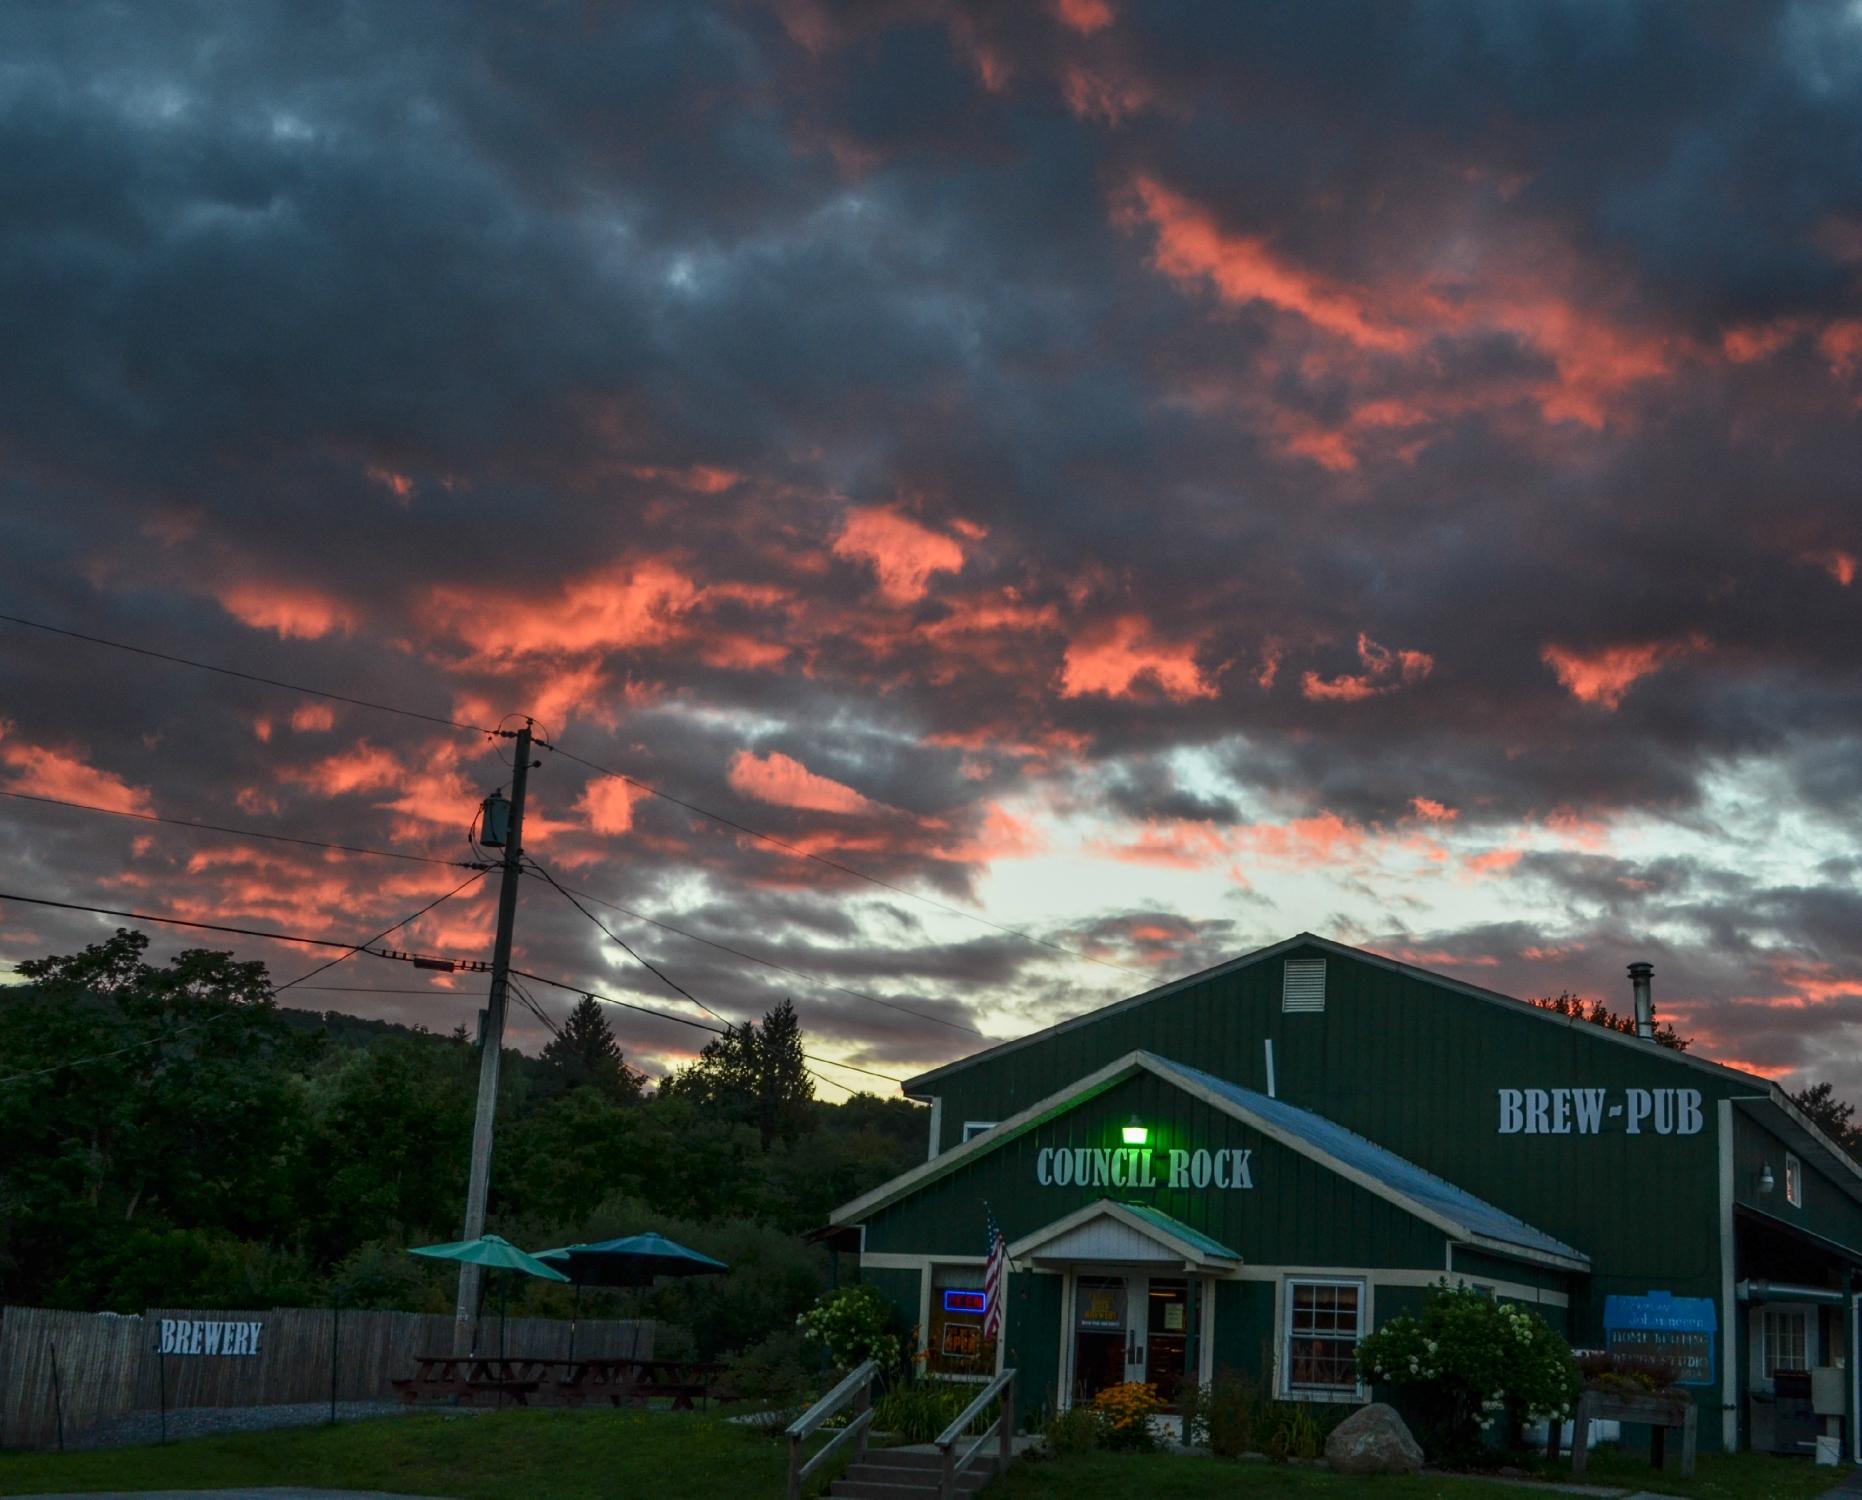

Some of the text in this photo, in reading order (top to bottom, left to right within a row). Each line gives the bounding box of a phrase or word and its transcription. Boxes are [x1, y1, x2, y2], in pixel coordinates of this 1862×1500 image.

[1498, 1088, 1704, 1135] BREW-PUB
[1037, 1148, 1253, 1189] COUNCIL ROCK
[158, 1319, 263, 1355] BREWERY
